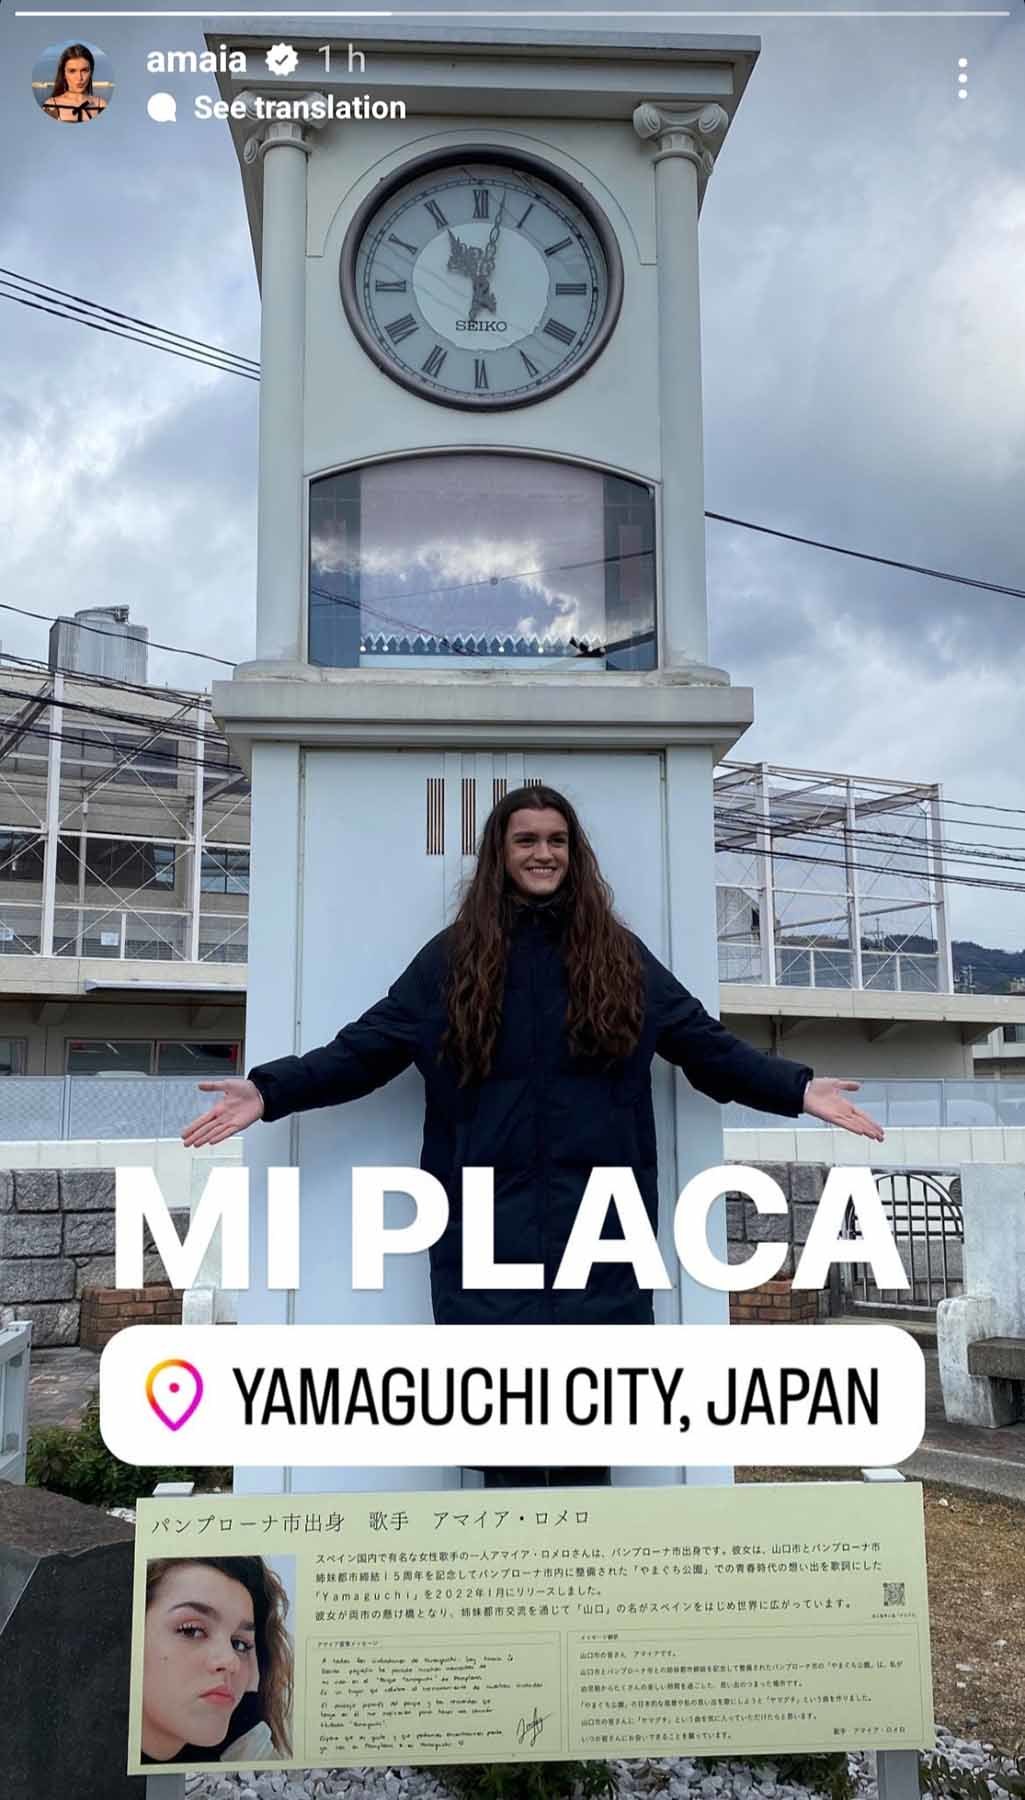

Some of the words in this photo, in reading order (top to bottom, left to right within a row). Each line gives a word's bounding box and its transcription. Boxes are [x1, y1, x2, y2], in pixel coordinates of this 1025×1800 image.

[473, 189, 489, 219] XII
[455, 320, 508, 332] SEIKO
[151, 1511, 345, 1535] パンプローナ市出身
[369, 1511, 409, 1531] 歌手
[433, 1509, 589, 1530] アマイア・ロメロ
